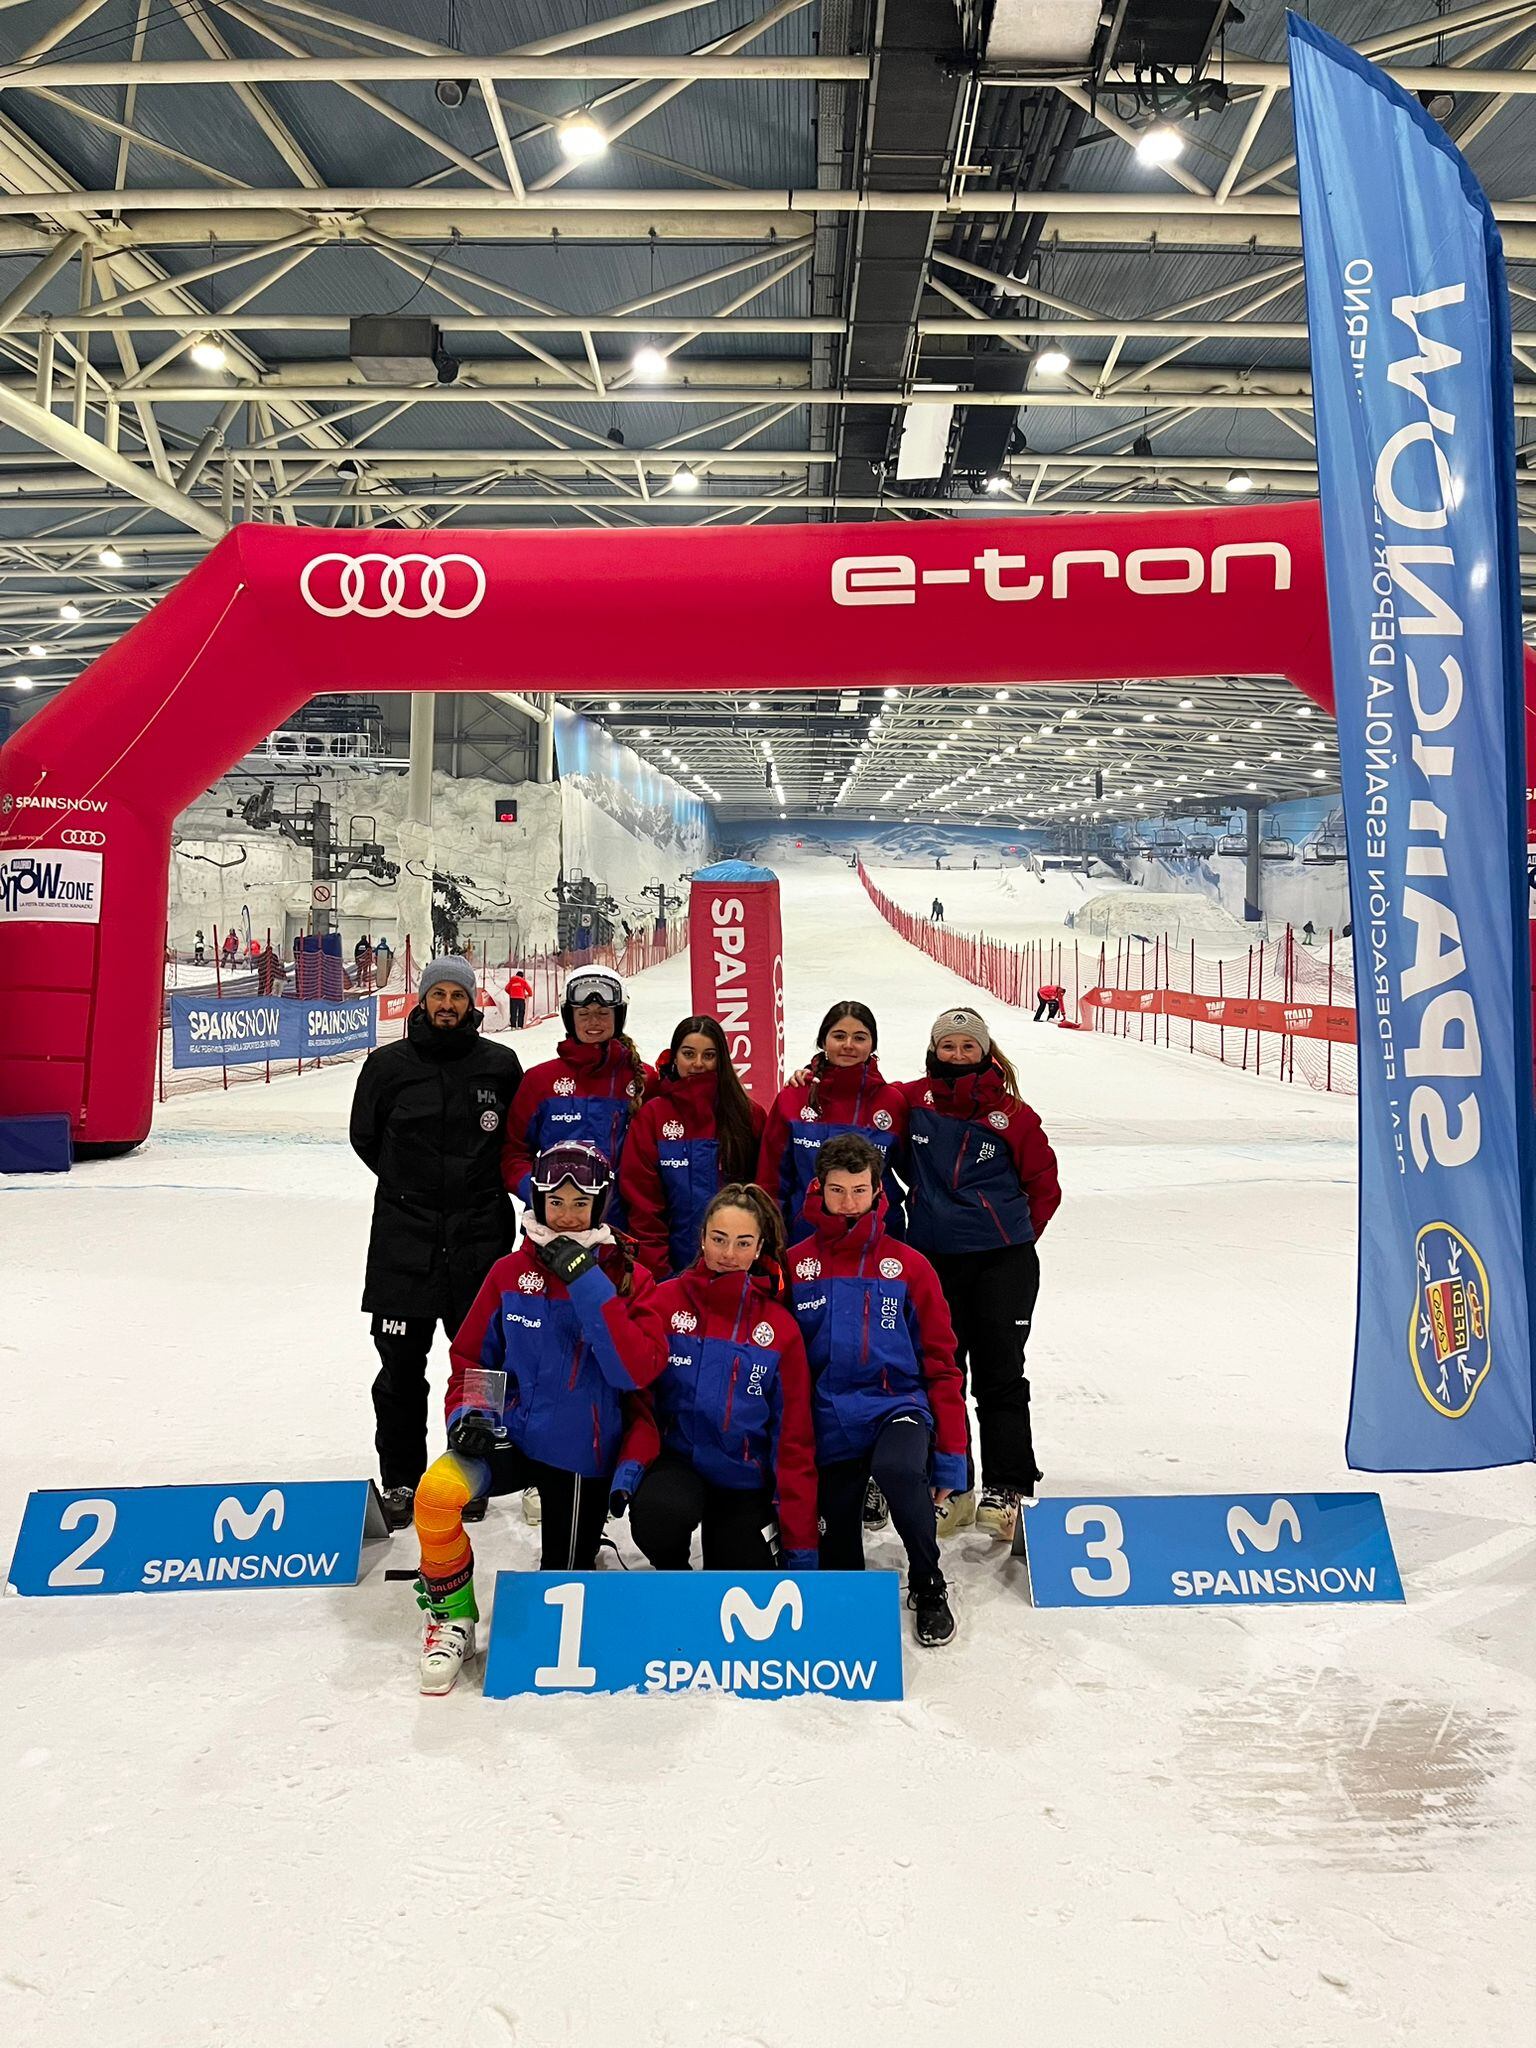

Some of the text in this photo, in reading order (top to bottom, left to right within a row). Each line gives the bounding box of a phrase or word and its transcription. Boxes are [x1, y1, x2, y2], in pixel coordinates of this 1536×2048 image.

[831, 542, 1291, 606] e-tron
[15, 796, 108, 813] SPAINSNOW
[188, 1008, 280, 1041] SPAINSNOW
[477, 1089, 497, 1104] HH
[381, 1318, 407, 1336] HH
[47, 1498, 117, 1588] 2
[1064, 1504, 1131, 1598] 3
[141, 1552, 340, 1585] SPAINSNOW
[1170, 1566, 1376, 1598] SPAINSNOW
[534, 1582, 597, 1688] 1
[644, 1659, 878, 1690] SPAINSNOW
